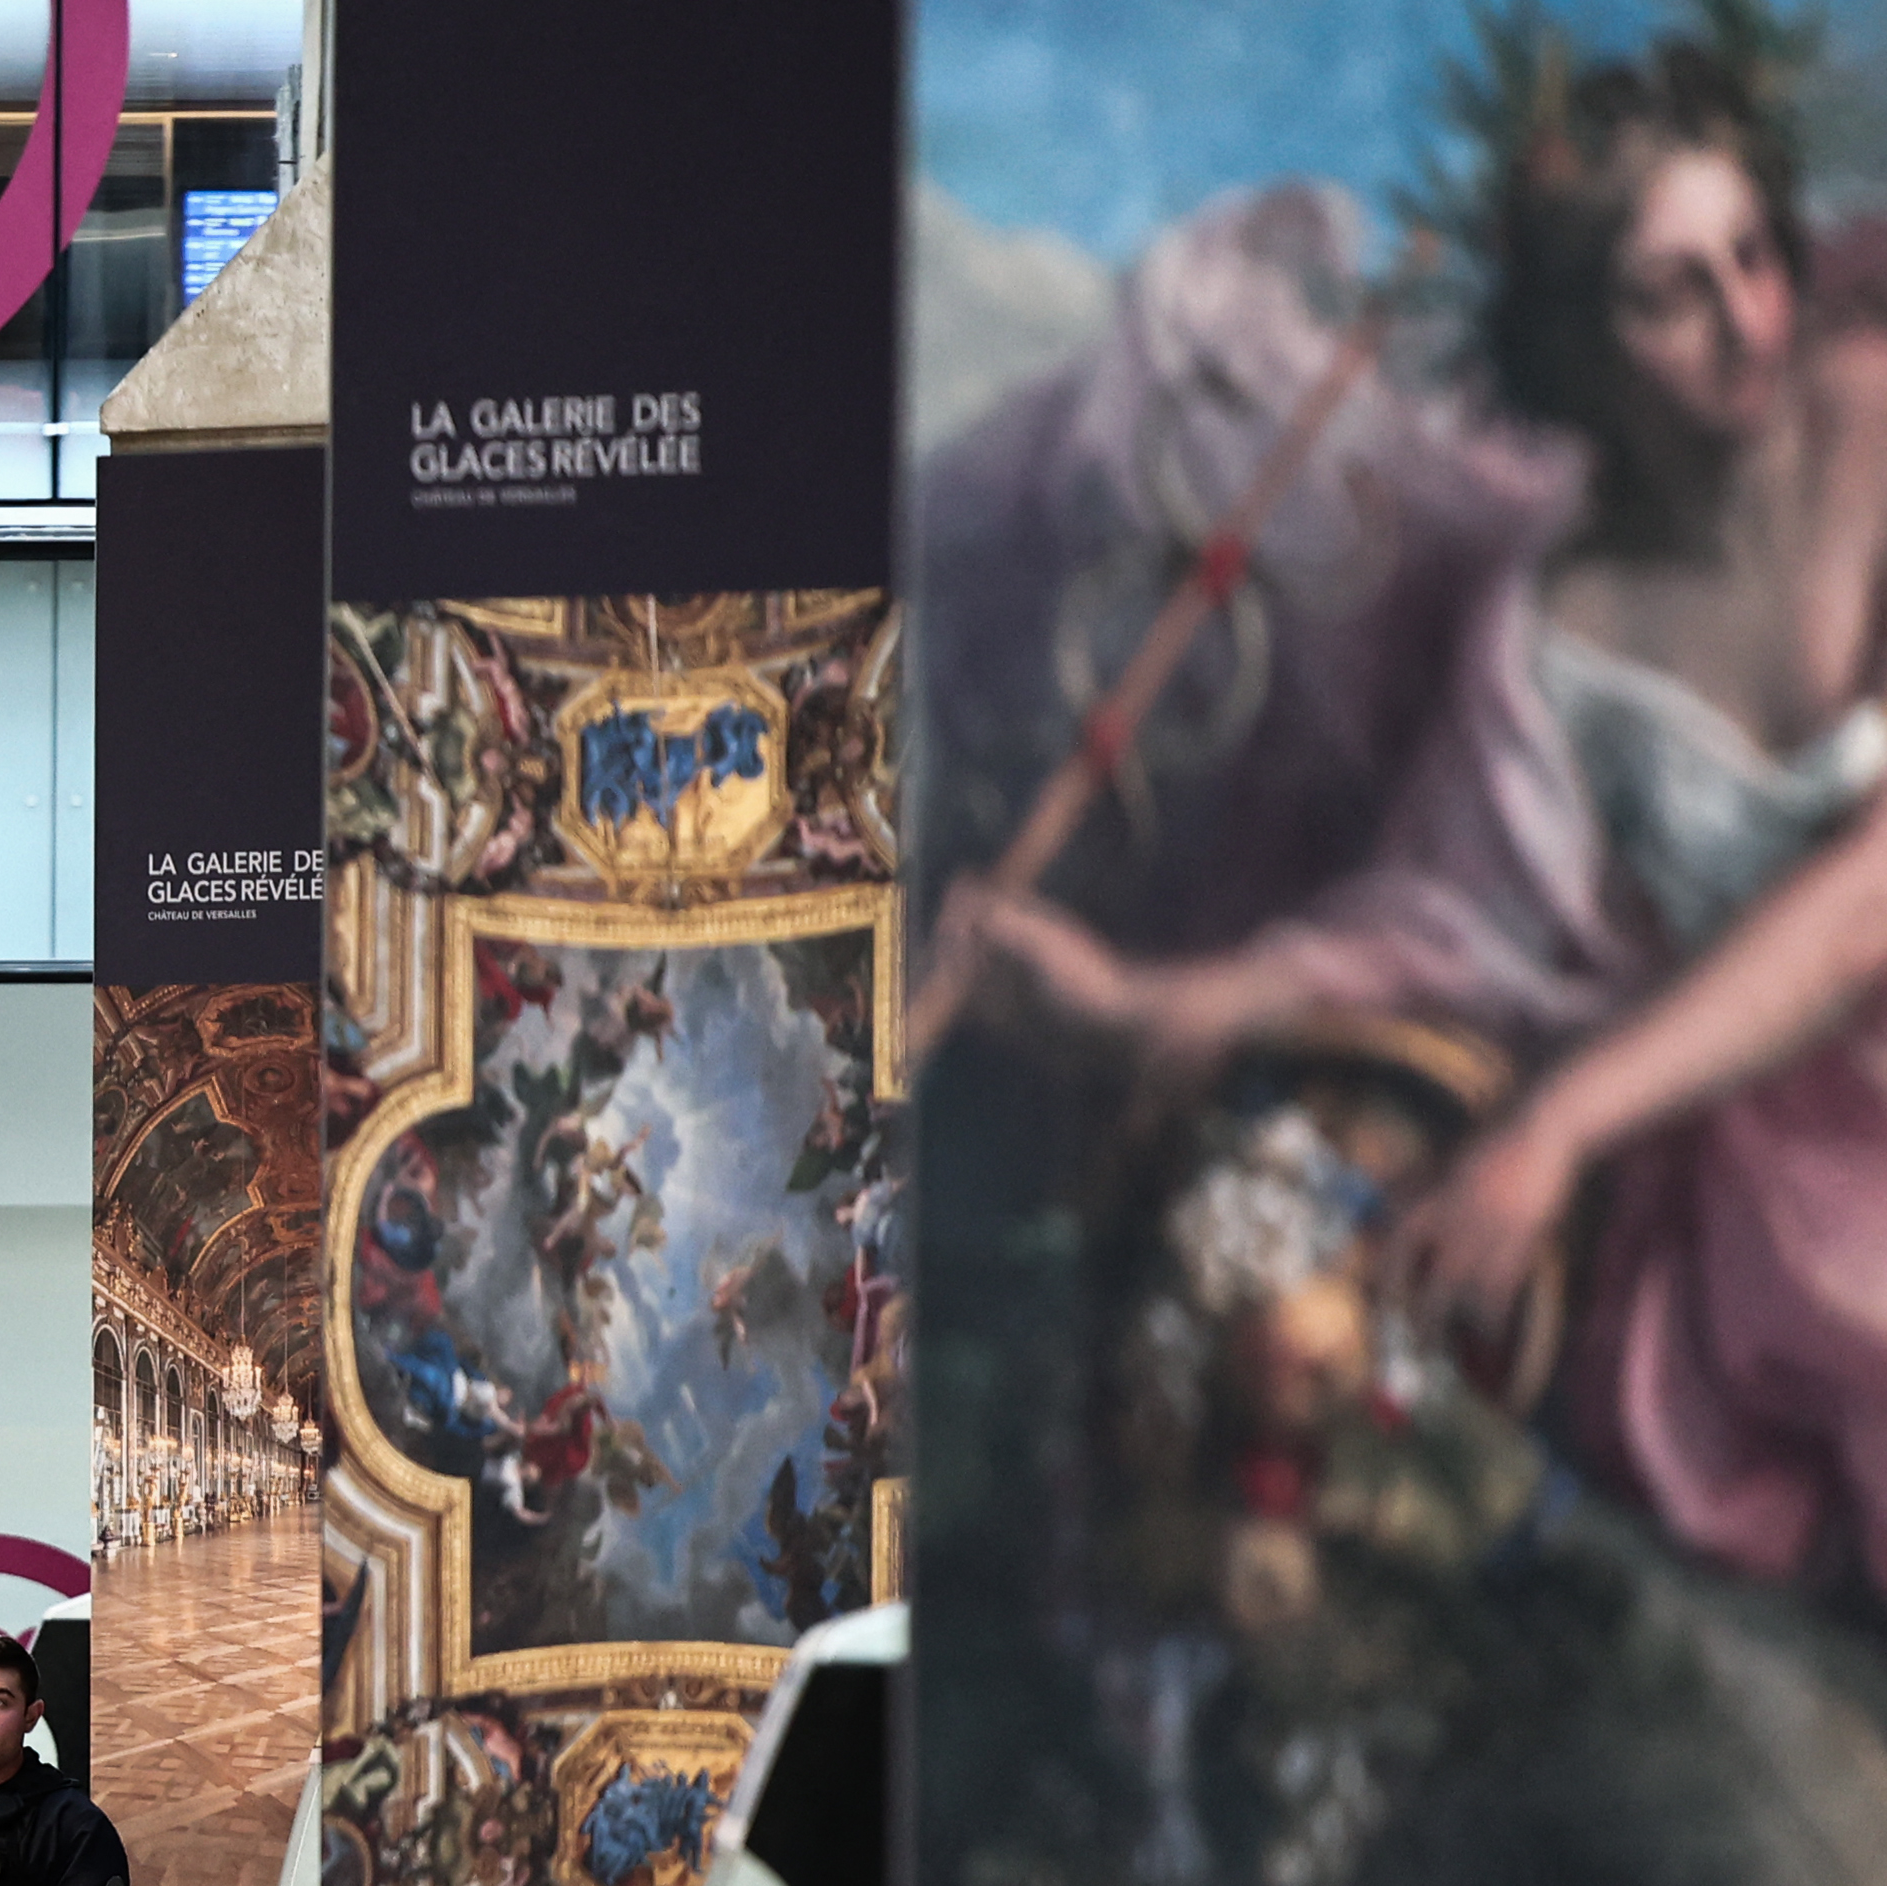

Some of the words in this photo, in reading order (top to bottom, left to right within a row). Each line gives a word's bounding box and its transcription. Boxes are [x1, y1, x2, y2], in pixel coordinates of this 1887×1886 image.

[410, 401, 456, 440] LA
[471, 396, 615, 437] GALERIE
[632, 391, 702, 432] DES
[410, 441, 546, 482] GLACES
[148, 853, 176, 875] LA
[187, 850, 282, 875] GALERIE
[147, 879, 237, 903] GLACES
[148, 908, 190, 921] CHÂTEAU
[192, 910, 204, 920] DE
[206, 908, 257, 920] VERSAILLES
